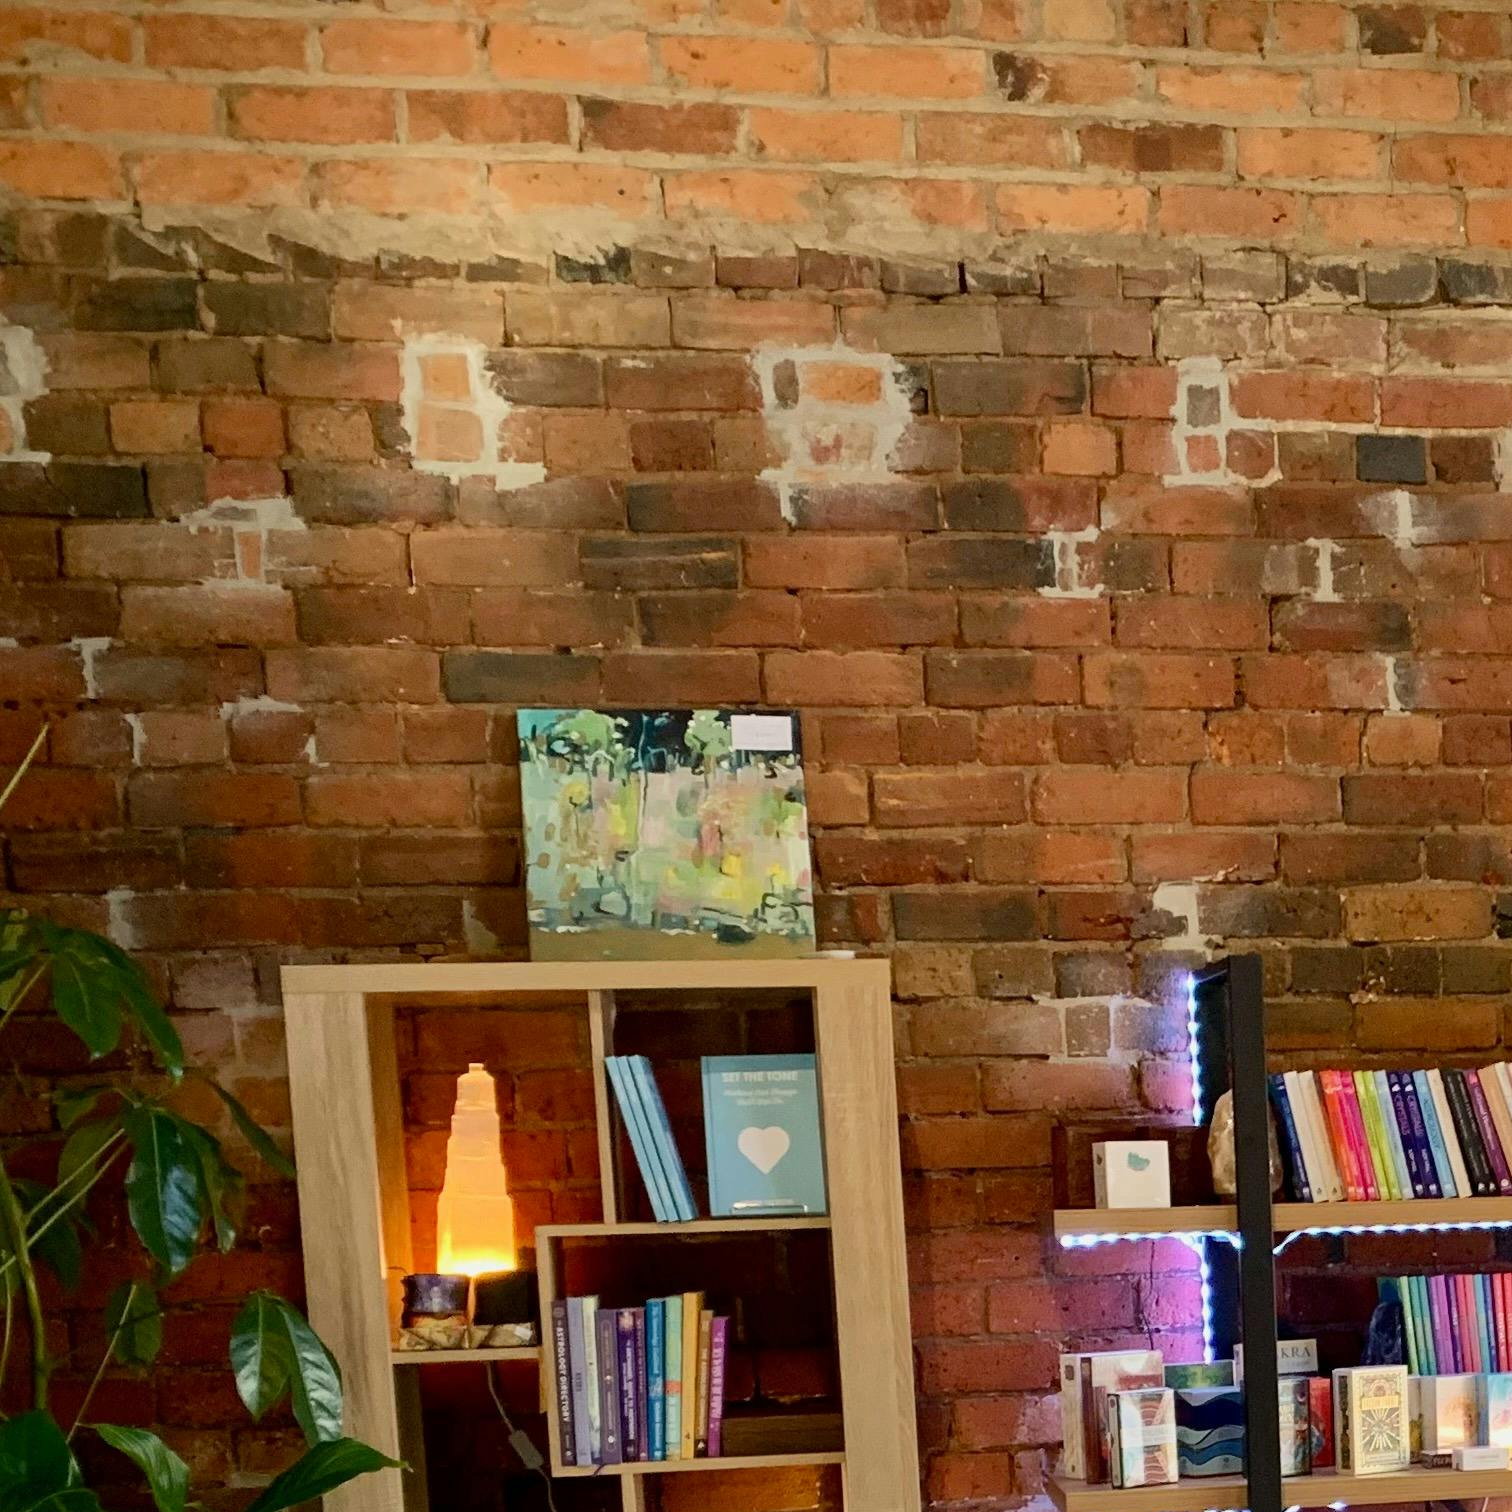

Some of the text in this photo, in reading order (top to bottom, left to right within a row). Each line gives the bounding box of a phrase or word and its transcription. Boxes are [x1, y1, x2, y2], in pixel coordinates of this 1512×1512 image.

[721, 1070, 799, 1083] SET THE TONE
[1281, 1346, 1311, 1359] KRA
[556, 1327, 571, 1422] ASTROLOGY DIRECTORY
